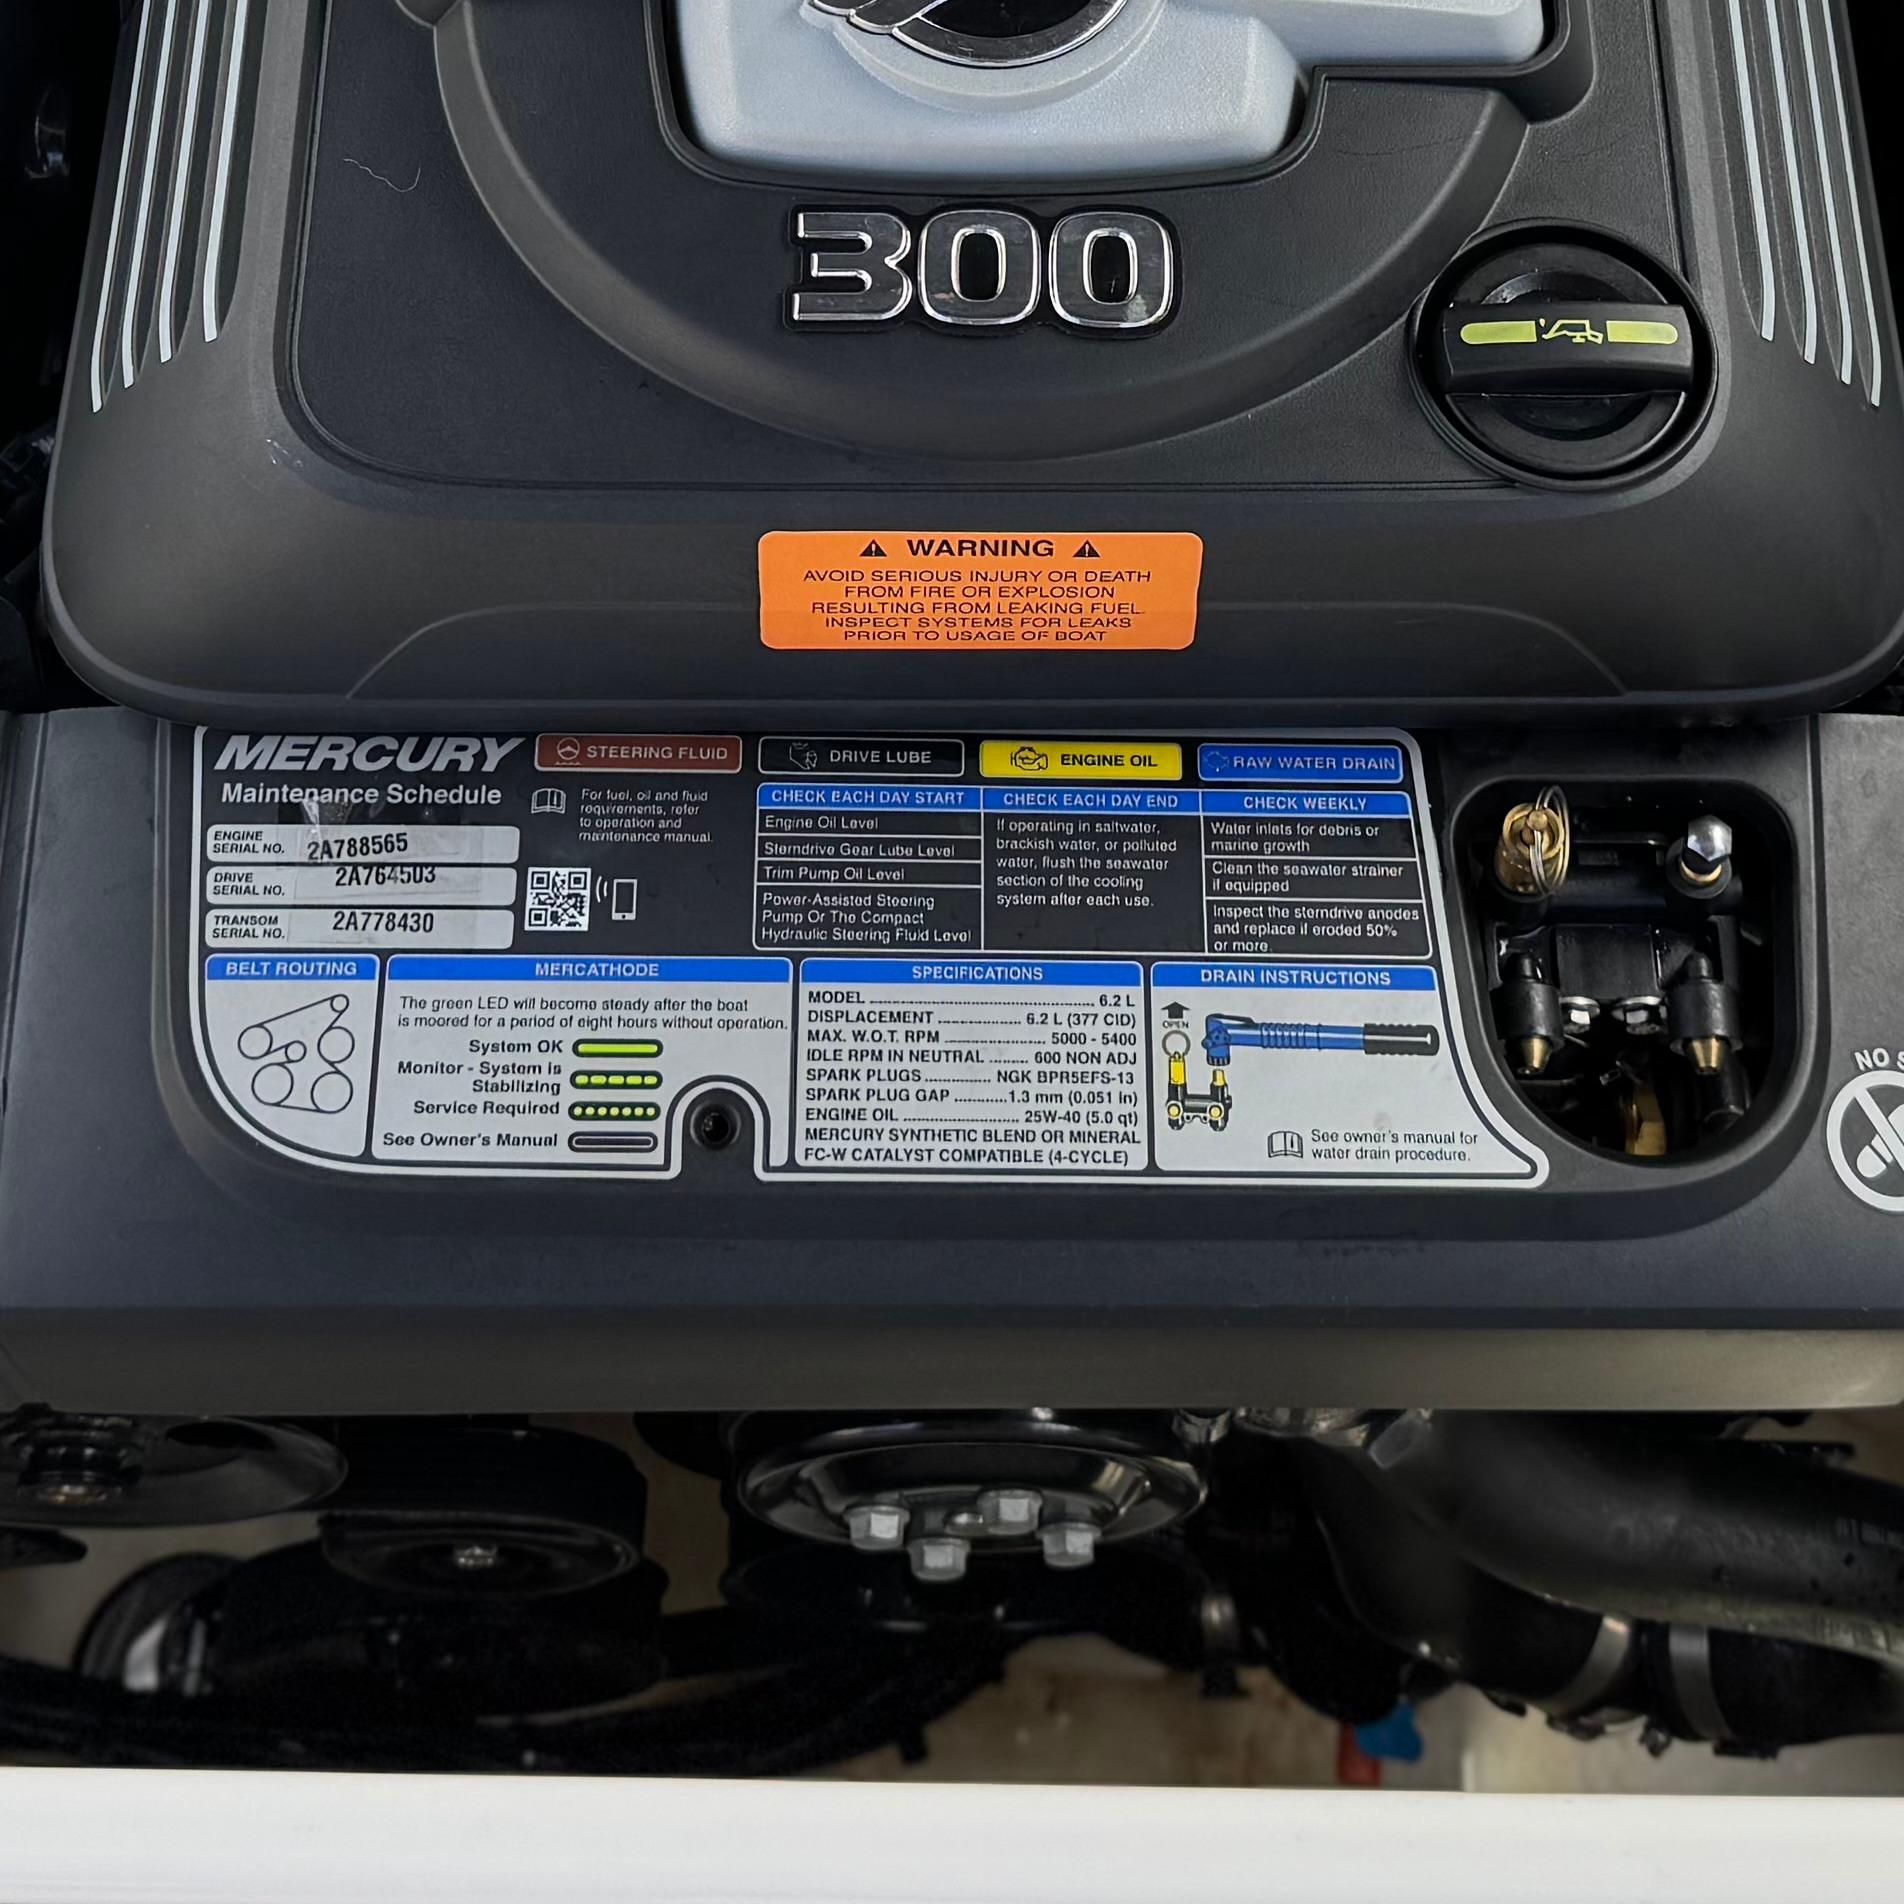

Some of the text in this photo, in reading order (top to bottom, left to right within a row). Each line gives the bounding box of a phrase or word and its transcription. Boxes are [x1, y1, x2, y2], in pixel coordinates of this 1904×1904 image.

[793, 209, 1174, 328] 300
[907, 539, 1054, 557] WARNING
[803, 570, 1151, 582] AVOID SERIOUS INJURY OR DEATH
[845, 586, 1115, 598] FROM FIRE OR EXPLOSION
[812, 602, 924, 614] RESULTING
[932, 603, 990, 614] FROM
[997, 603, 1083, 614] LEAKING
[826, 617, 1131, 628] INSPECT SYSTEMS FOR LEAKS
[844, 631, 1107, 641] PRIOR TO USAGE OF BOAT
[213, 735, 527, 772] MERCURY
[587, 746, 728, 760] STEERING FLUID
[829, 750, 932, 764] DRIVE LUBE
[1060, 754, 1158, 767] ENGINE OIL
[1233, 756, 1395, 769] RAW WATER DRAIN
[221, 782, 502, 804] Maintenance Schedule
[771, 790, 964, 805] CHECK EACH DAY START
[1003, 793, 1178, 808] CHECK EACH DAY END
[1244, 797, 1366, 810] CHECK WEEKLY
[765, 816, 878, 831] Engine Oil Level
[214, 831, 263, 841] ENGINE
[213, 844, 285, 854] SERIAL NO.
[307, 832, 408, 861] 2A788565
[214, 872, 253, 882] DRIVE
[335, 866, 436, 886] 2A764503
[764, 866, 905, 882] Trim Pump Oil Level
[213, 885, 285, 896] SERIAL NO.
[214, 915, 279, 925] TRANSOM
[332, 912, 434, 933] 2A778430
[212, 928, 285, 938] SERIAL NO.
[226, 962, 357, 976] BELT ROUTING
[535, 963, 659, 976] MERCATHODE
[912, 966, 1044, 981] SPECIFICATIONS
[1201, 969, 1391, 986] DRAIN INSTRUCTIONS
[808, 991, 1135, 1007] MODEL 6.2 L
[808, 1011, 1136, 1028] DISPLACEMENT 6.2 L (377 CID)
[807, 1030, 847, 1042] MAX.
[852, 1031, 899, 1043] W.O.T.
[905, 1031, 940, 1043] RPM
[1051, 1033, 1087, 1044] 5000
[1101, 1033, 1136, 1046] 5400
[469, 1040, 563, 1055] System OK
[807, 1049, 1137, 1065] IDLE RPM IN NEUTRAL 600 NON ADJ
[1854, 1048, 1889, 1071] NO
[398, 1061, 463, 1075] Monitor
[479, 1062, 542, 1077] System
[807, 1069, 1134, 1084] SPARK PLUGS NGK BPR5EFS-13
[472, 1079, 561, 1095] Stabilizing
[806, 1089, 1138, 1105] SPARK PLUG GAP 1.3 mm (0.051 in)
[414, 1101, 560, 1118] Service Required
[806, 1109, 1138, 1126] ENGINE OIL 25W-40 (5.0 qt)
[383, 1133, 558, 1147] See Owner's Manual
[805, 1128, 1141, 1144] MERCURY SYNTHETIC BLEND OR MINERAL
[1311, 1130, 1478, 1145] See owner's manual for
[804, 1148, 1128, 1166] FC-W CATALYST COMPATIBLE (4-CYCLE)
[1312, 1147, 1471, 1163] water drain procedure.
